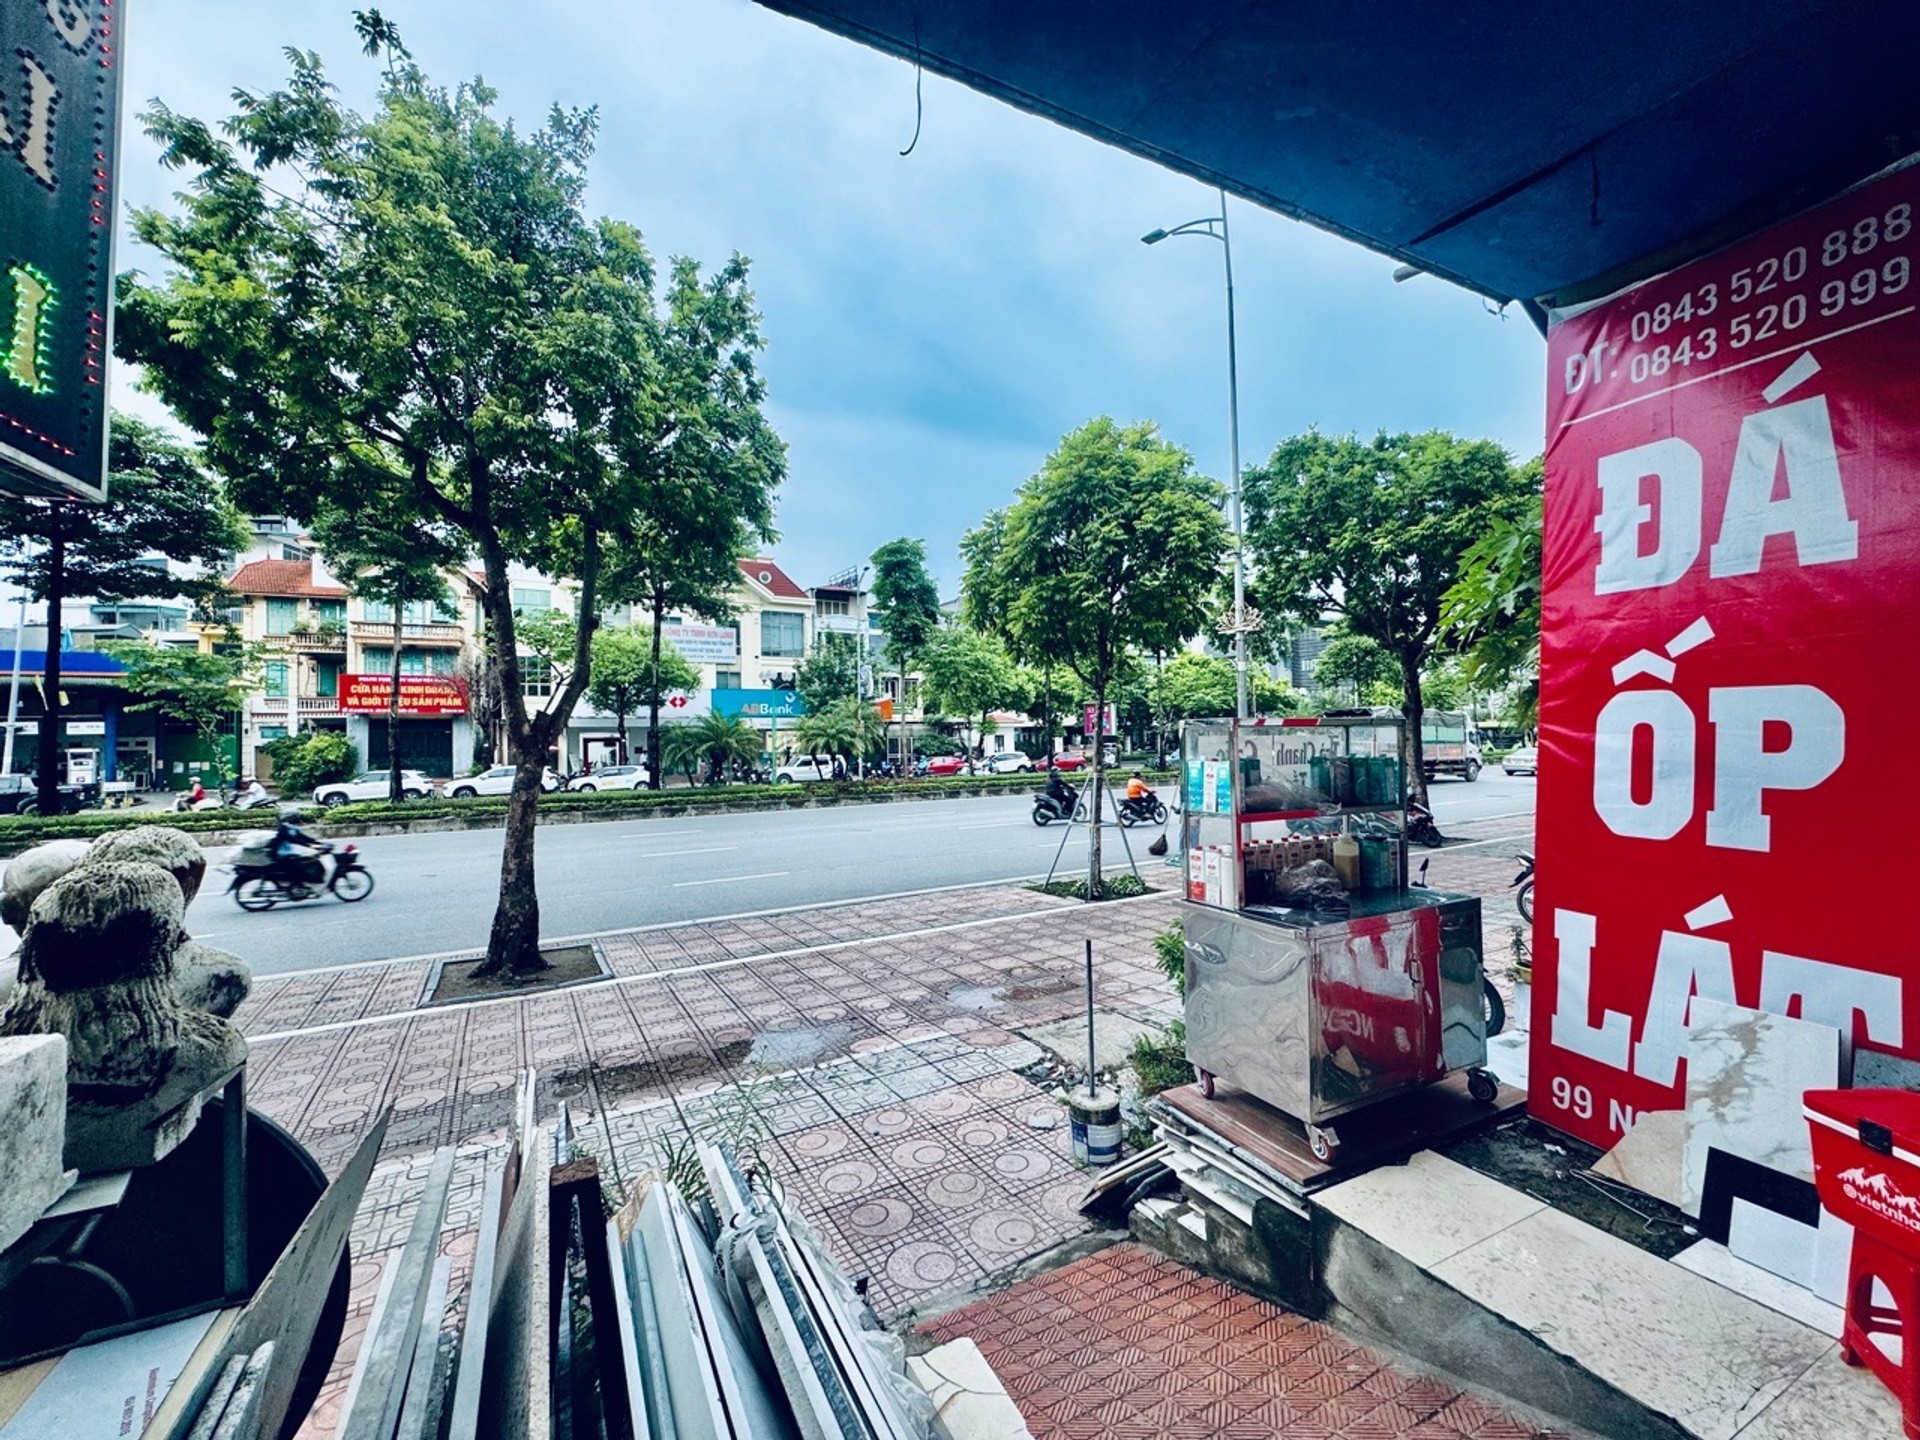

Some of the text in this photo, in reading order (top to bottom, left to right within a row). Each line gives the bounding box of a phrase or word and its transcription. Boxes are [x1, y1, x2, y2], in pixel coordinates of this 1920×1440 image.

[1630, 256, 1911, 384] 0843 520 999
[1631, 203, 1912, 343] 0843 520 888
[1594, 350, 1859, 596] ĐÁ
[346, 695, 360, 706] VÀ
[383, 695, 411, 707] TỆU
[372, 683, 394, 694] HÀN
[400, 685, 424, 694] KINH
[1592, 615, 1846, 853] ỐP
[1552, 1077, 1593, 1120] 99
